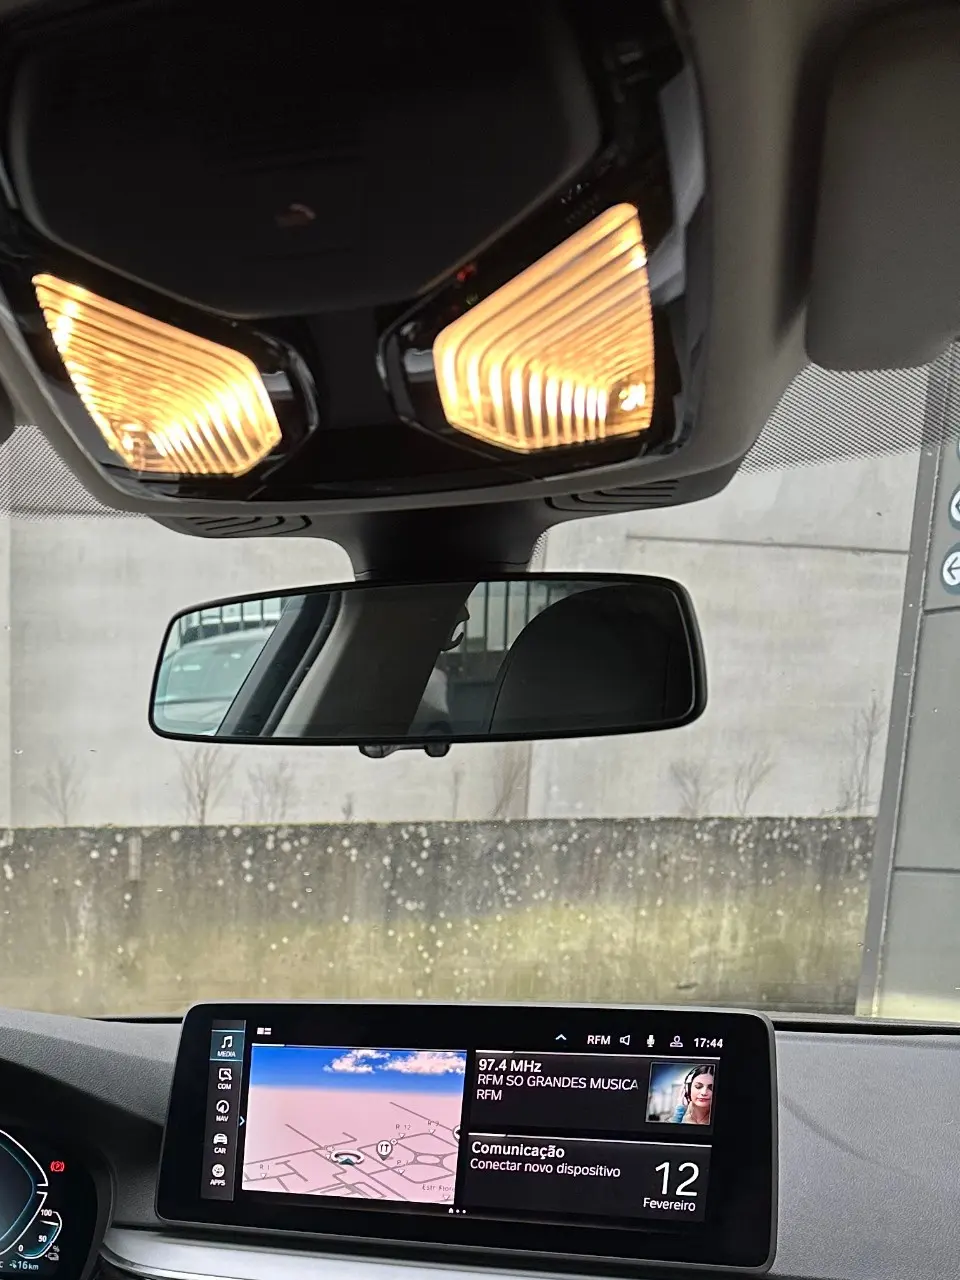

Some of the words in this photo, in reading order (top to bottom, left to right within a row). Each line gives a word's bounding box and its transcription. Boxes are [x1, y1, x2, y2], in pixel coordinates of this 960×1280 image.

[587, 1035, 611, 1046] RFM
[693, 1037, 724, 1049] 17:44
[217, 1050, 236, 1058] MEDIA
[478, 1058, 507, 1072] 97.4
[510, 1060, 542, 1073] MHz
[477, 1074, 503, 1086] RFM
[505, 1075, 524, 1087] SO
[526, 1076, 587, 1089] GRANDES
[476, 1089, 502, 1101] RFM
[471, 1141, 565, 1160] Comunicação
[470, 1158, 522, 1172] Conectar
[524, 1163, 553, 1173] novo
[556, 1162, 621, 1178] dispositivo
[654, 1161, 700, 1197] 12
[643, 1197, 696, 1212] Fevereiro
[41, 1209, 53, 1217] 100
[38, 1235, 47, 1243] 50
[18, 1244, 24, 1252] 0
